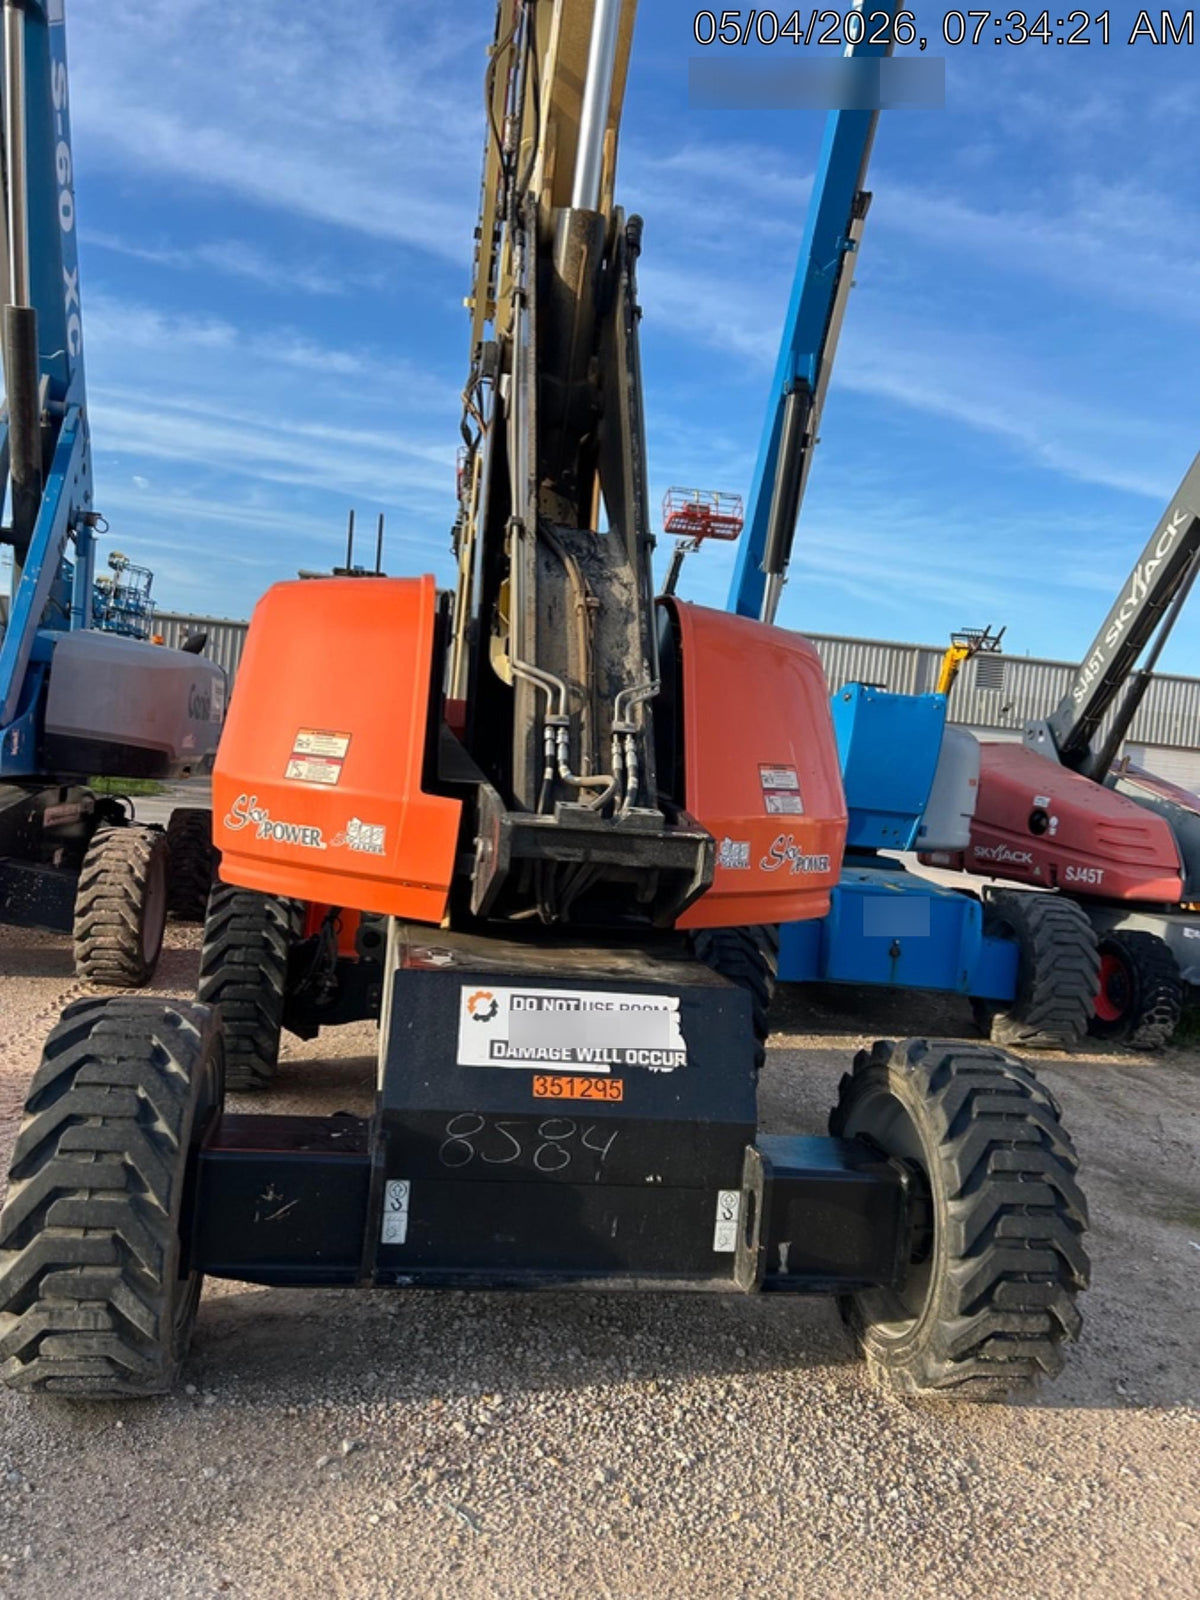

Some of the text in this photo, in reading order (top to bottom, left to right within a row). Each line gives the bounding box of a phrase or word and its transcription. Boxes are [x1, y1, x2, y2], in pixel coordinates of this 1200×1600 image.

[51, 58, 82, 358] S-60 XC
[1072, 508, 1189, 704] SJ45T SKYJACK
[973, 842, 1034, 866] SKYJACK
[1064, 864, 1105, 886] SJ45T
[513, 997, 537, 1011] DO
[542, 998, 579, 1011] NOT
[493, 1042, 687, 1067] DAMAGE WILL OCCUR
[534, 1076, 622, 1099] 351295
[438, 1112, 619, 1172] 8584
